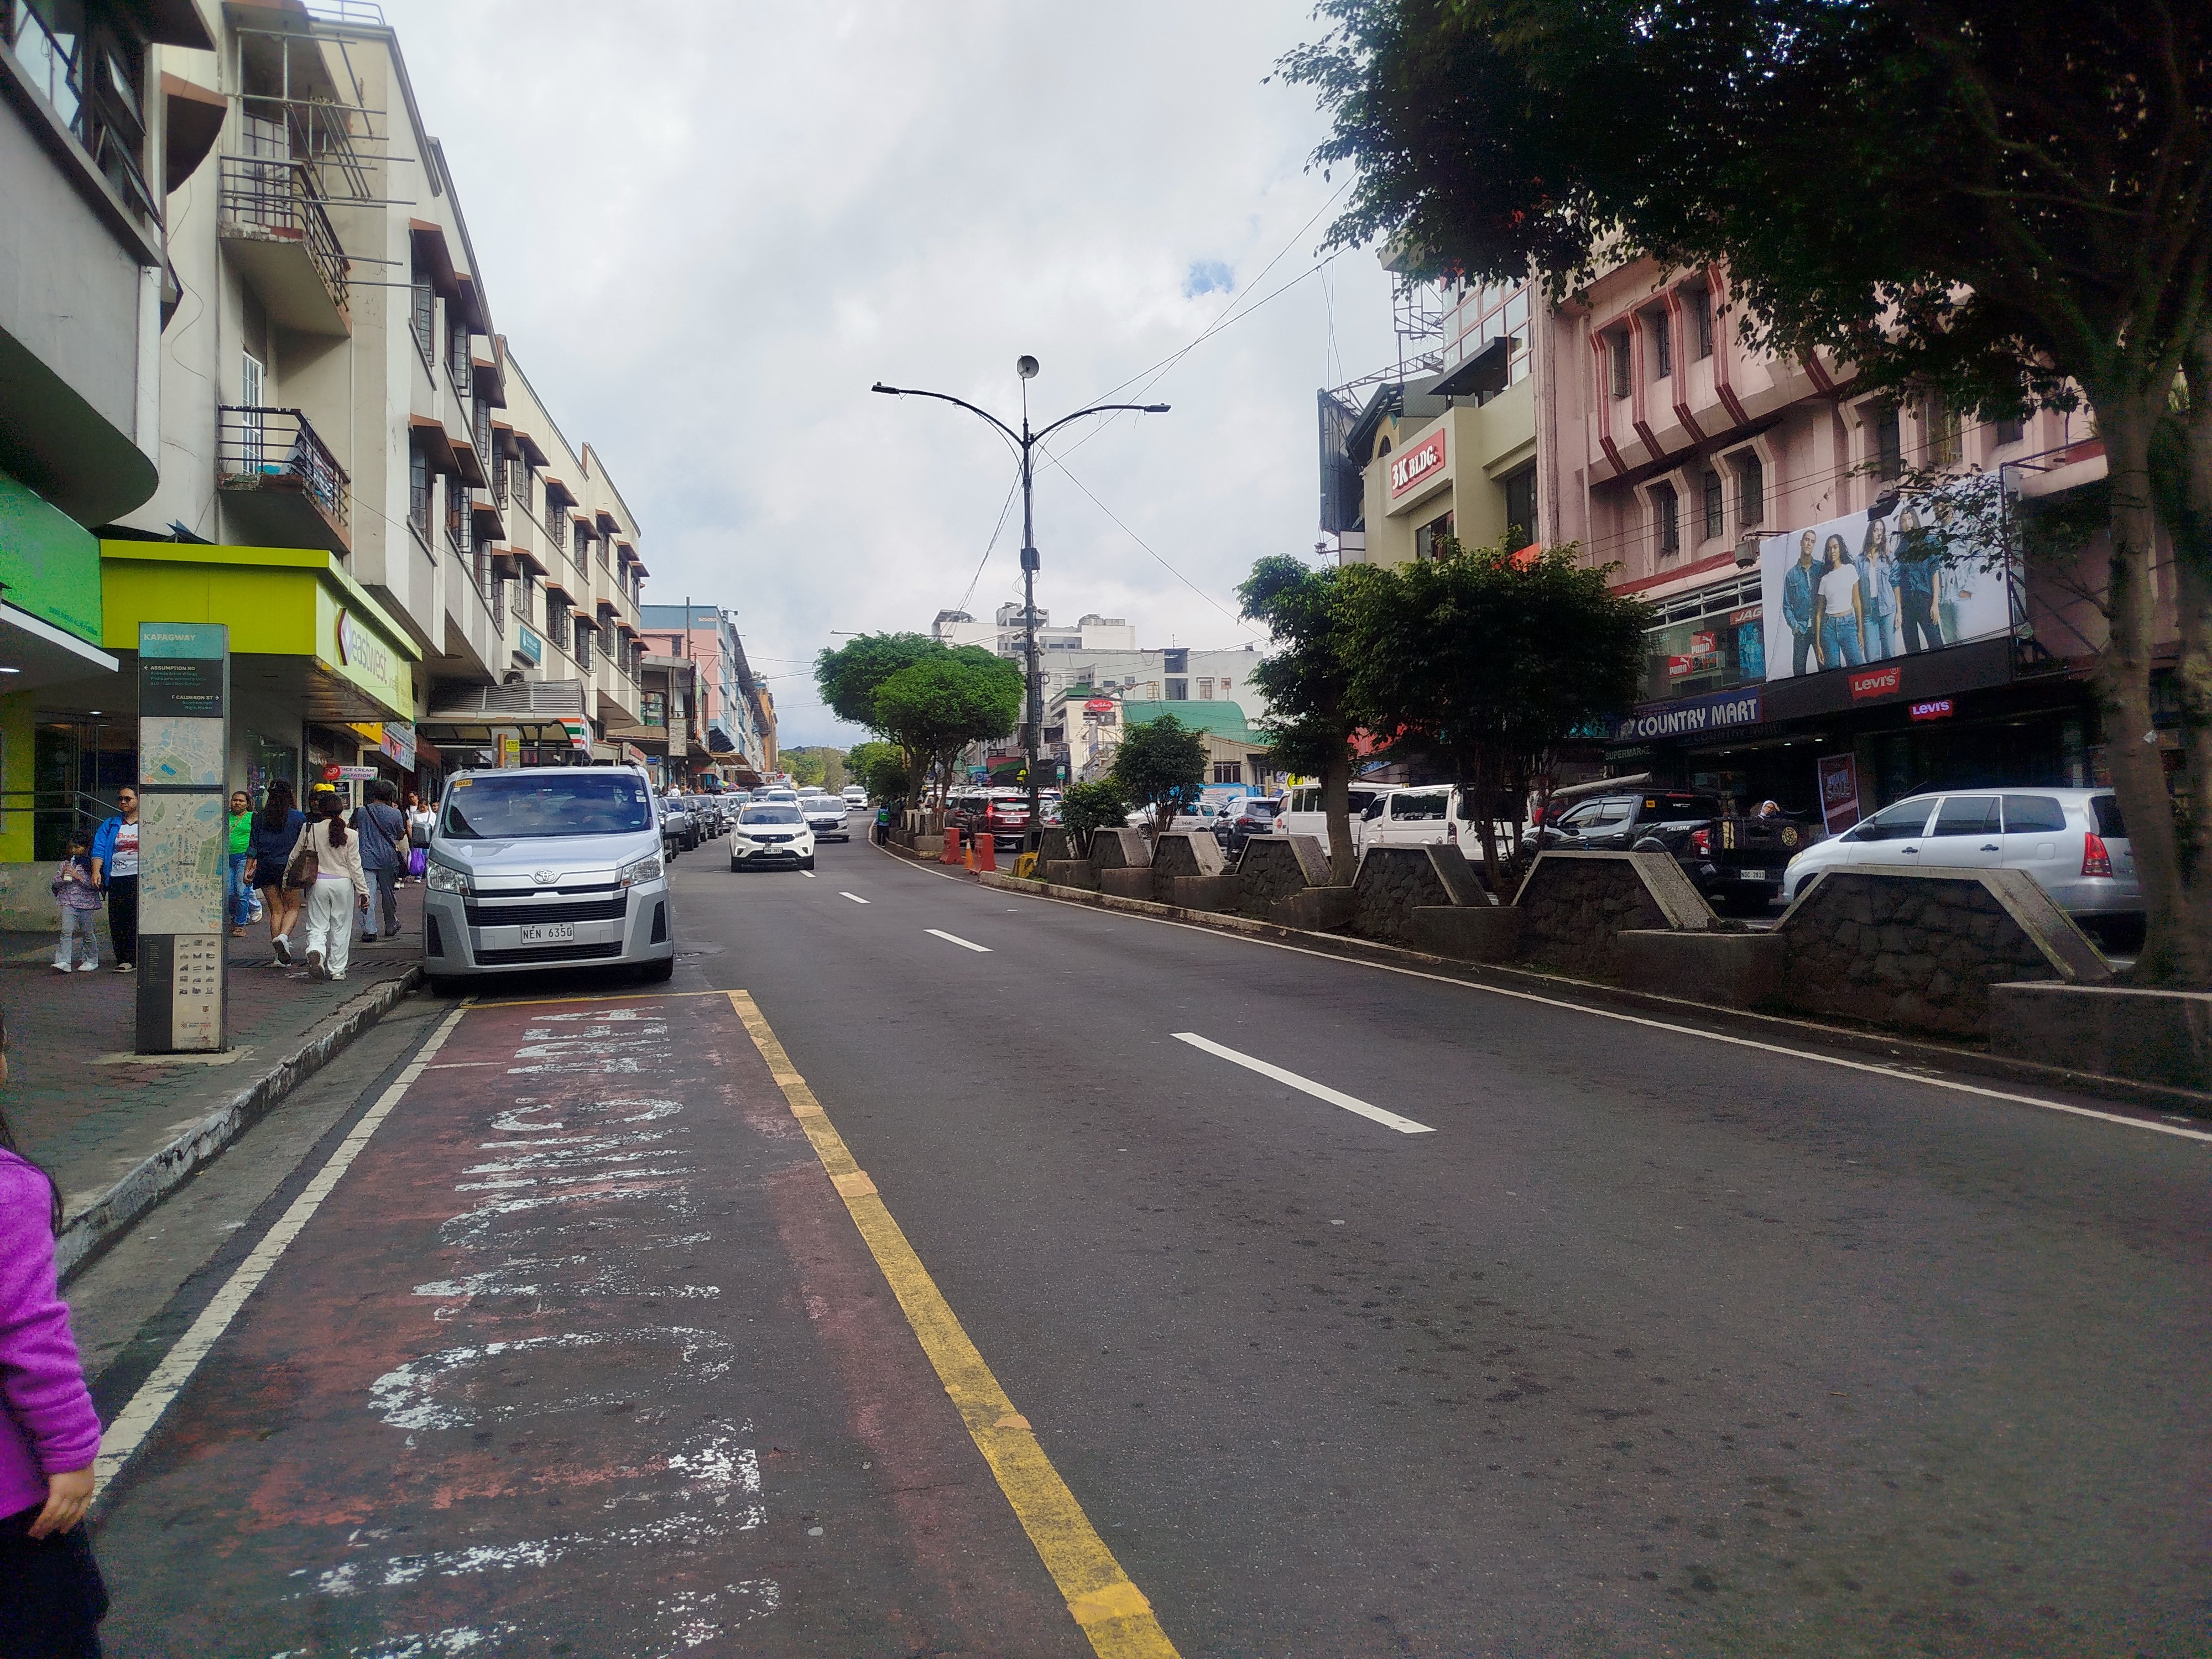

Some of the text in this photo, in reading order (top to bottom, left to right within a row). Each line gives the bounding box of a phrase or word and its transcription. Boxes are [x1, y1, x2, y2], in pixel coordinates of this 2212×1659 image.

[1392, 445, 1437, 490] 3K BLDG.
[1735, 608, 1762, 622] JAG
[1691, 643, 1710, 654] PUMA
[352, 629, 387, 684] eastwest
[1669, 664, 1687, 675] PUMA
[1637, 708, 1706, 736] COUNTRY
[1712, 699, 1757, 726] MART
[1605, 747, 1651, 760] SUPERMARKE
[523, 927, 572, 939] NEN 6350
[507, 1005, 675, 1074] AREA
